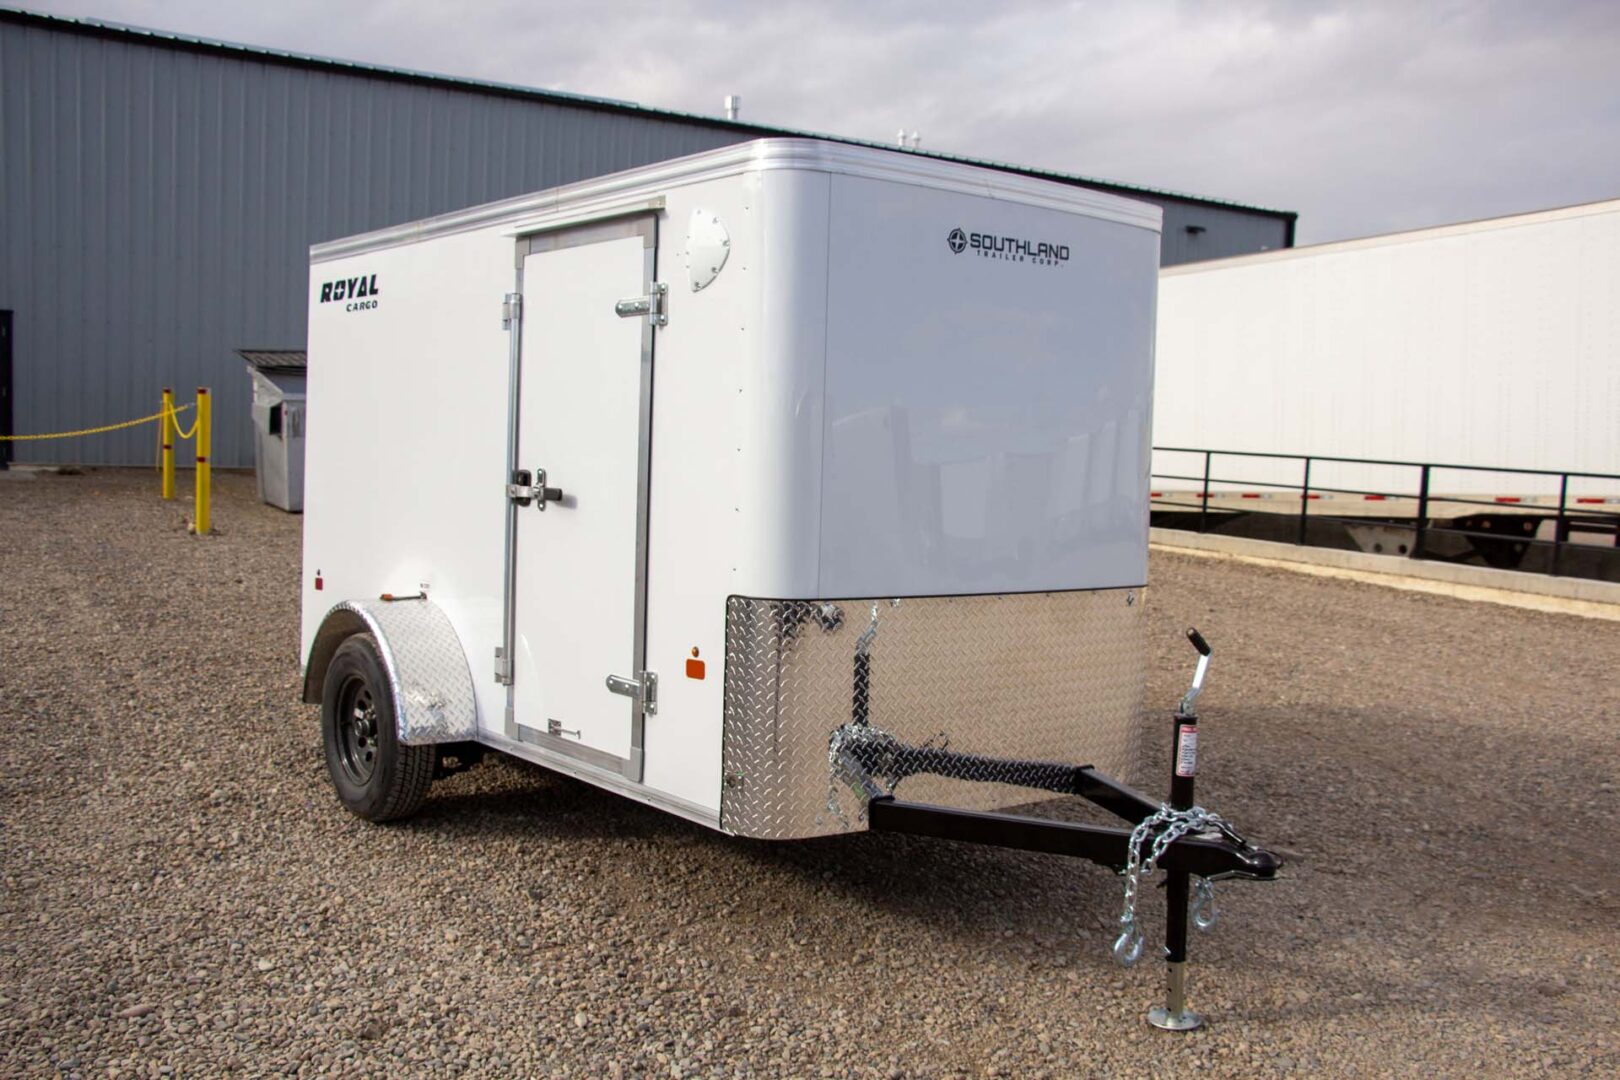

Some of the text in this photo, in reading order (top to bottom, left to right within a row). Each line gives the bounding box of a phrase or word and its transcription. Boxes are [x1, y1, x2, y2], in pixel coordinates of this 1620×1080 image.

[970, 233, 1069, 260] SOUTHLAND
[320, 274, 378, 303] ROYAL
[346, 300, 378, 312] CARGO
